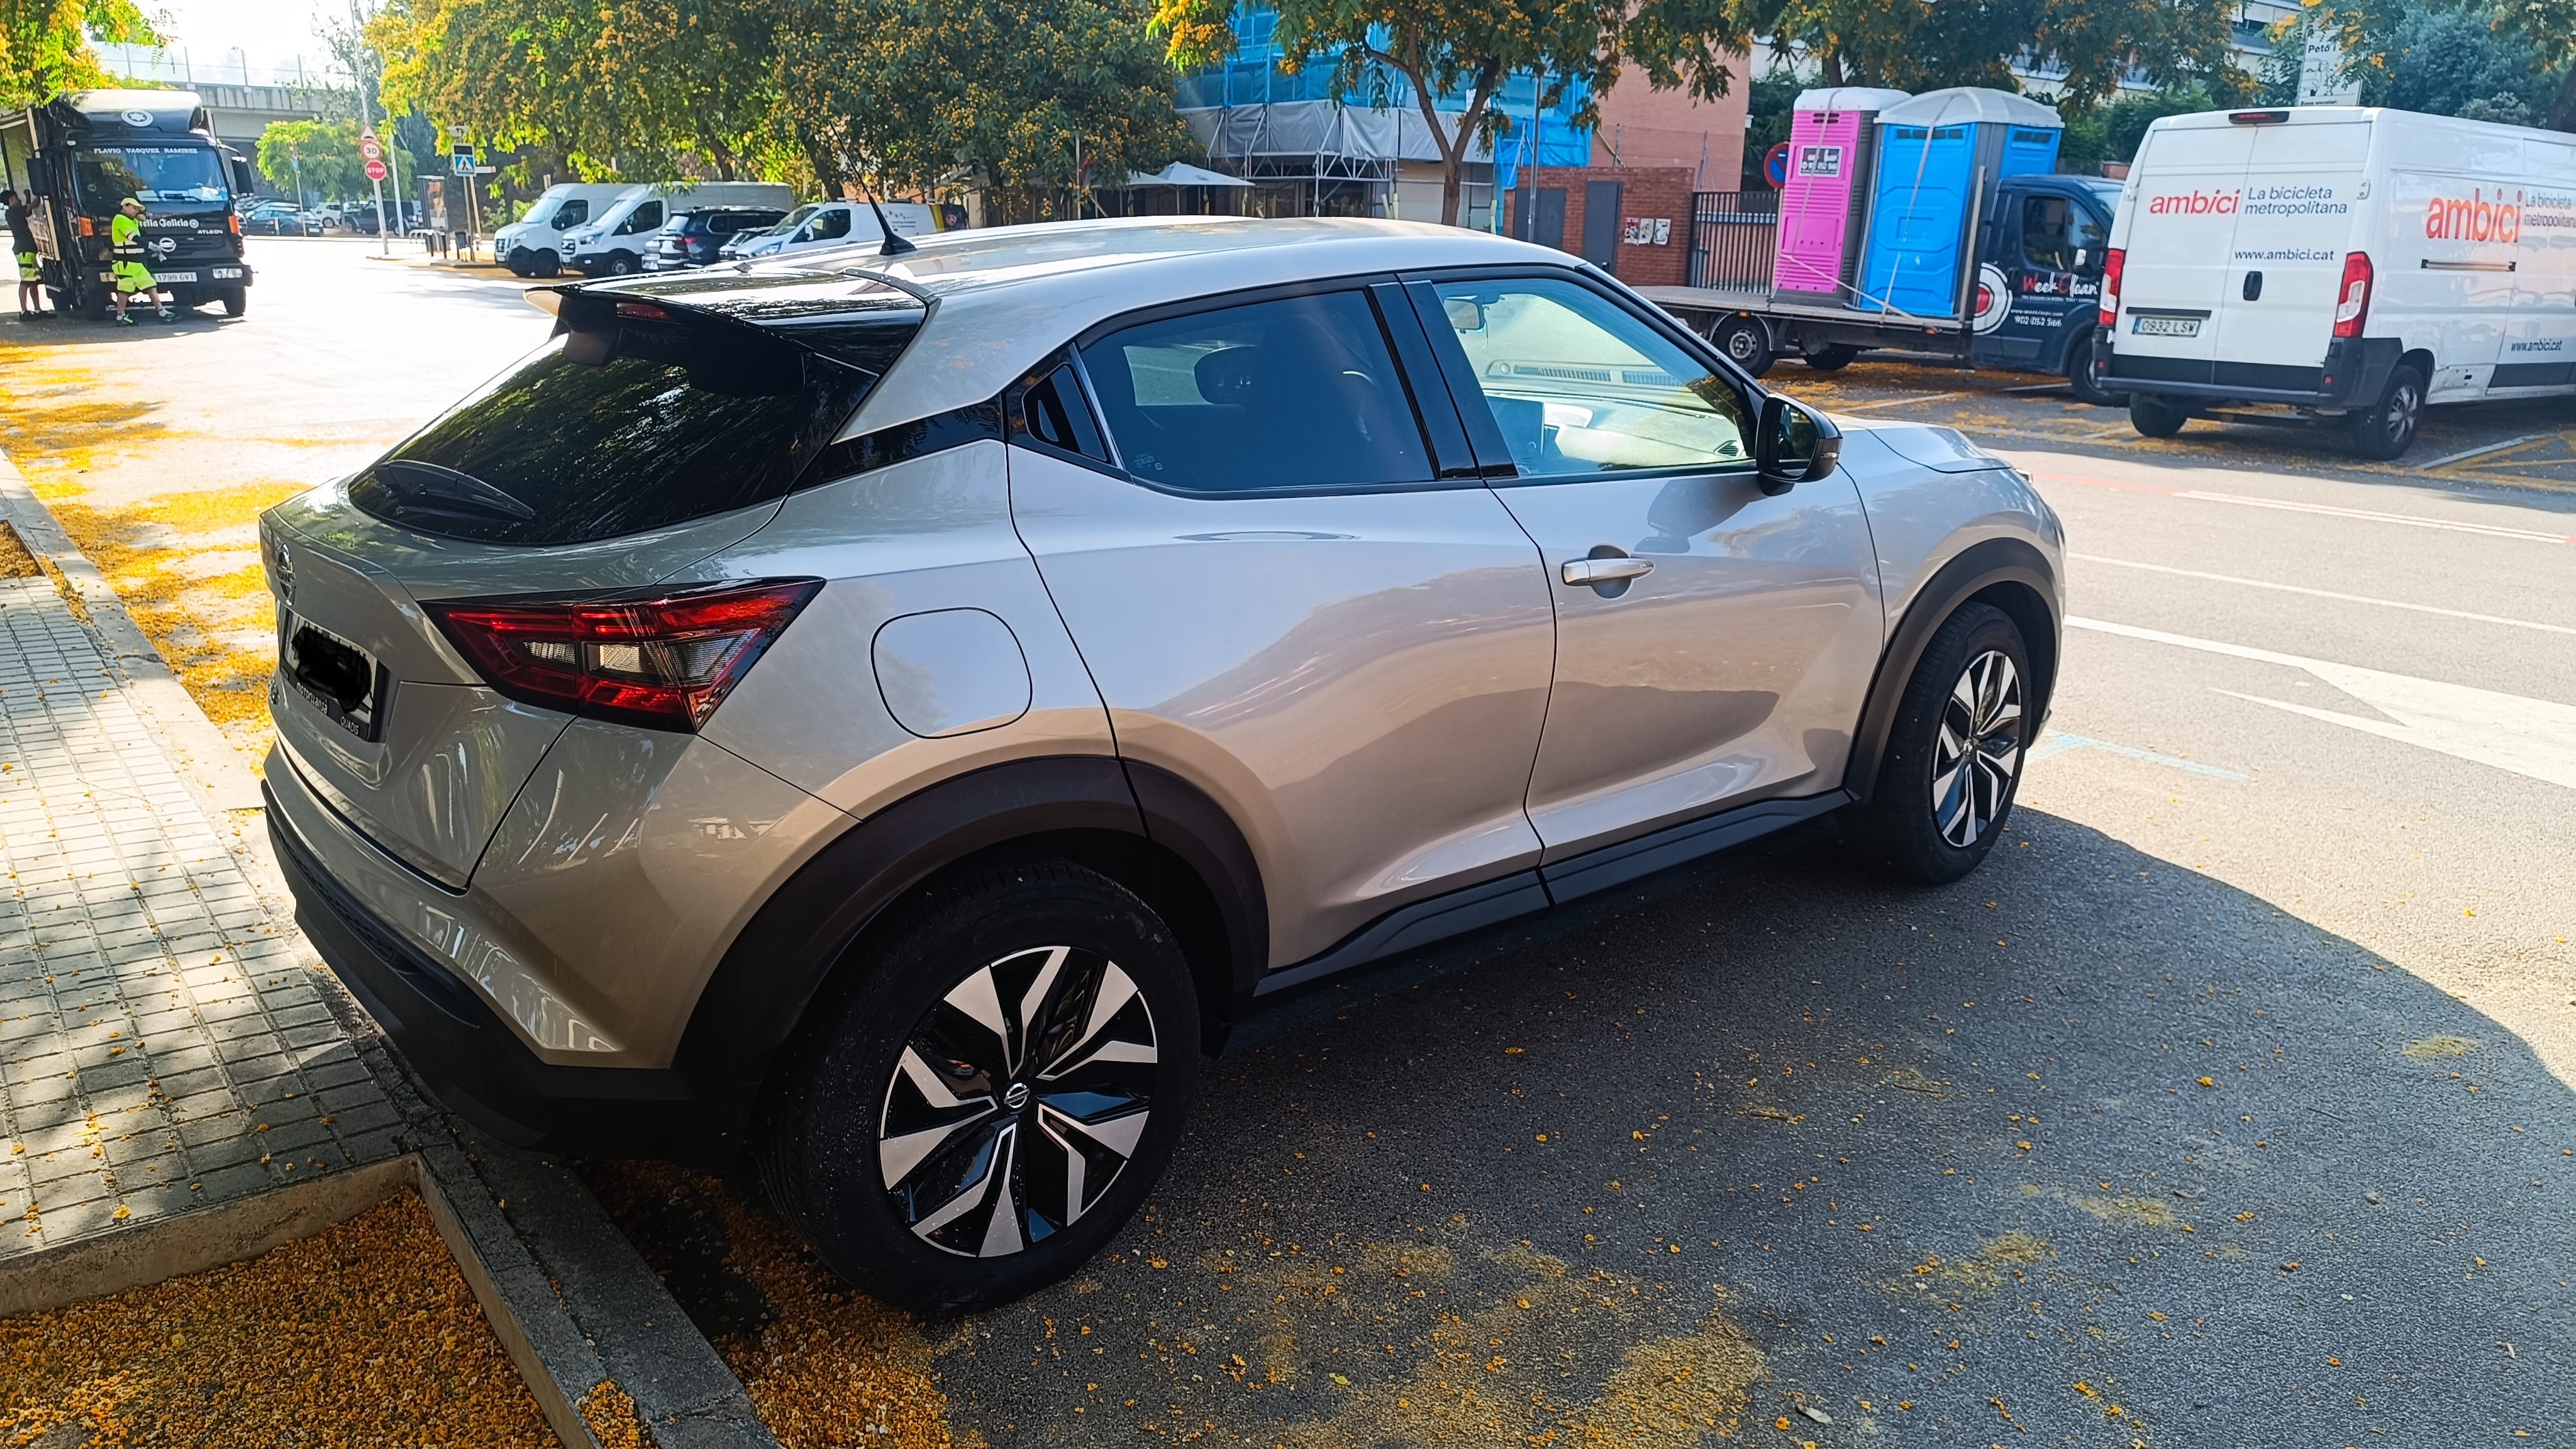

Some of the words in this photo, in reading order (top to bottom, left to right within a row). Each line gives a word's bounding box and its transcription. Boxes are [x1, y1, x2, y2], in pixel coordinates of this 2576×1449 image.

[2248, 187, 2266, 201] La
[2270, 186, 2332, 201] bicicleta
[2526, 191, 2536, 207] La
[2538, 191, 2572, 209] bicicleta
[2150, 189, 2241, 214] ambici
[2245, 202, 2348, 217] metropolitana
[2426, 187, 2522, 243] ambici
[158, 218, 189, 228] Galicia
[2524, 212, 2576, 231] metropolitan
[2234, 249, 2334, 260] www.ambici.cat
[2142, 321, 2170, 332] 0932
[2511, 338, 2562, 352] www.ambici.cat
[340, 716, 359, 735] QUADIS
